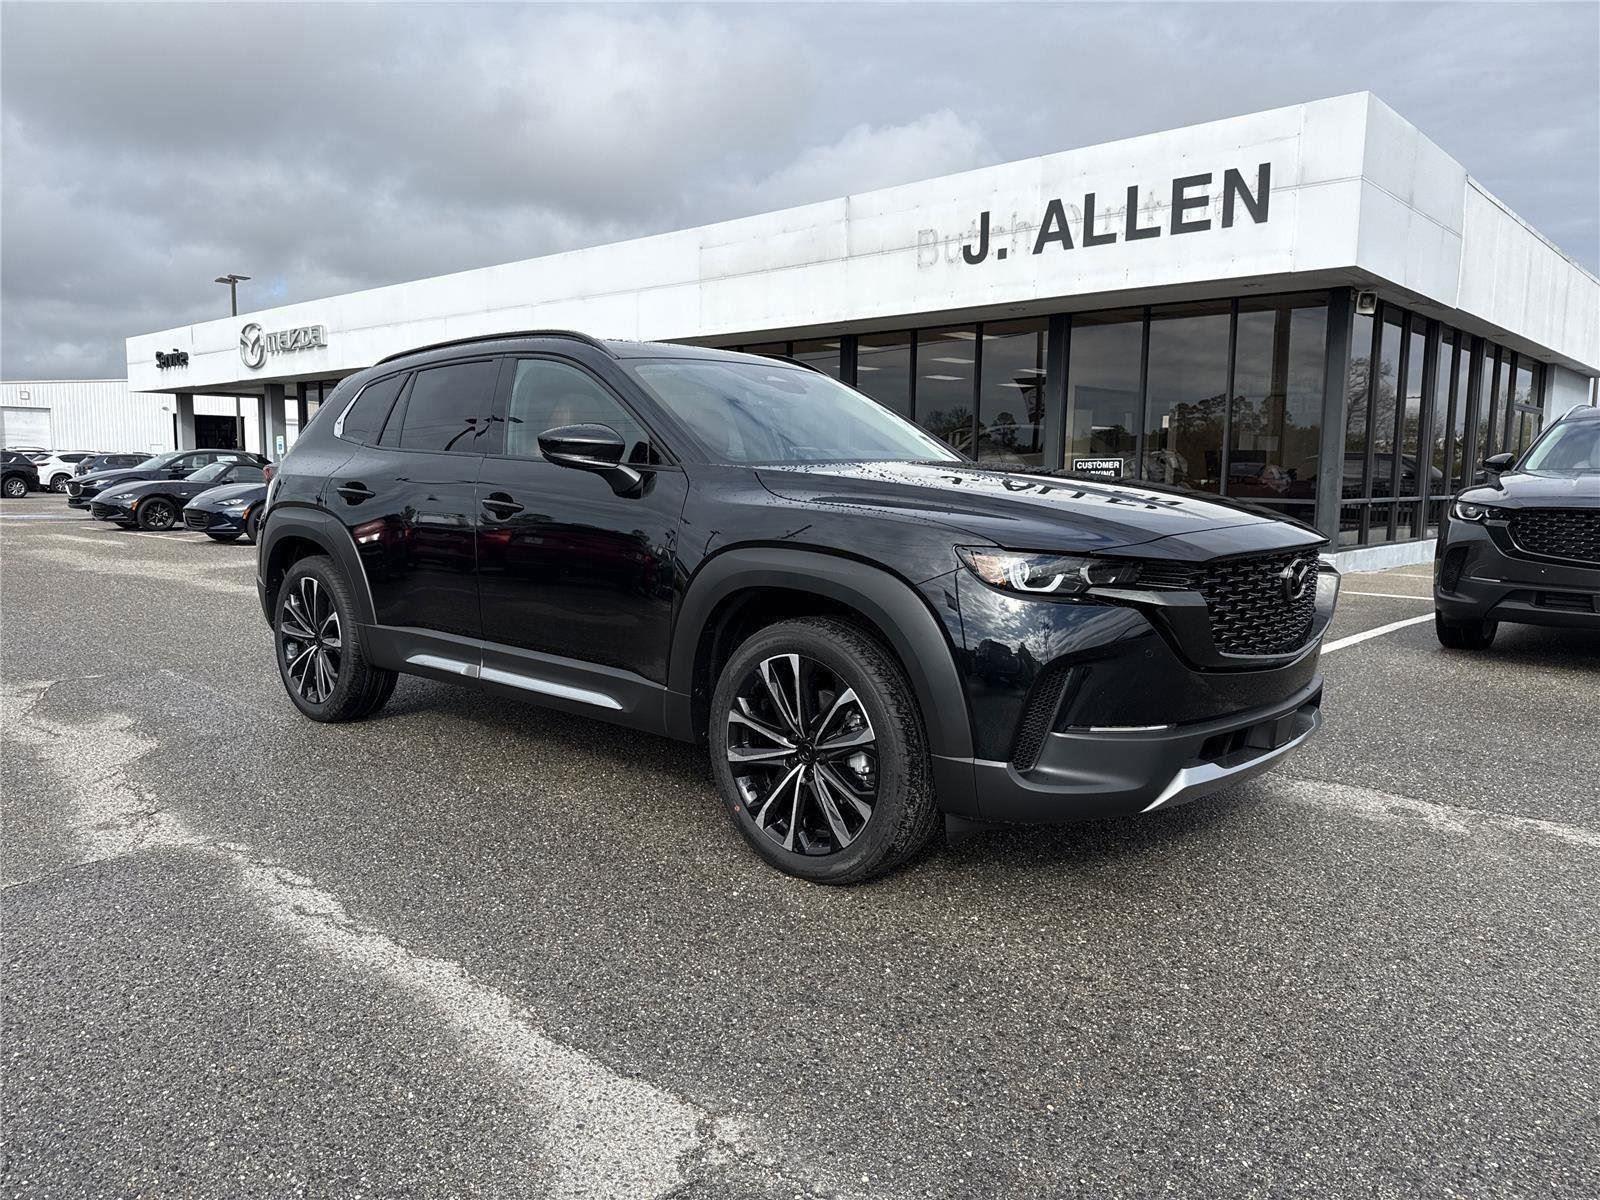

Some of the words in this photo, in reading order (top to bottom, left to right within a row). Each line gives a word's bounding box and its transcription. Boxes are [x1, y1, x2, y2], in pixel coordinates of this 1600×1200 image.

[963, 211, 1008, 265] J.
[1032, 162, 1271, 255] ALLEN
[1076, 461, 1120, 469] CUSTOMER
